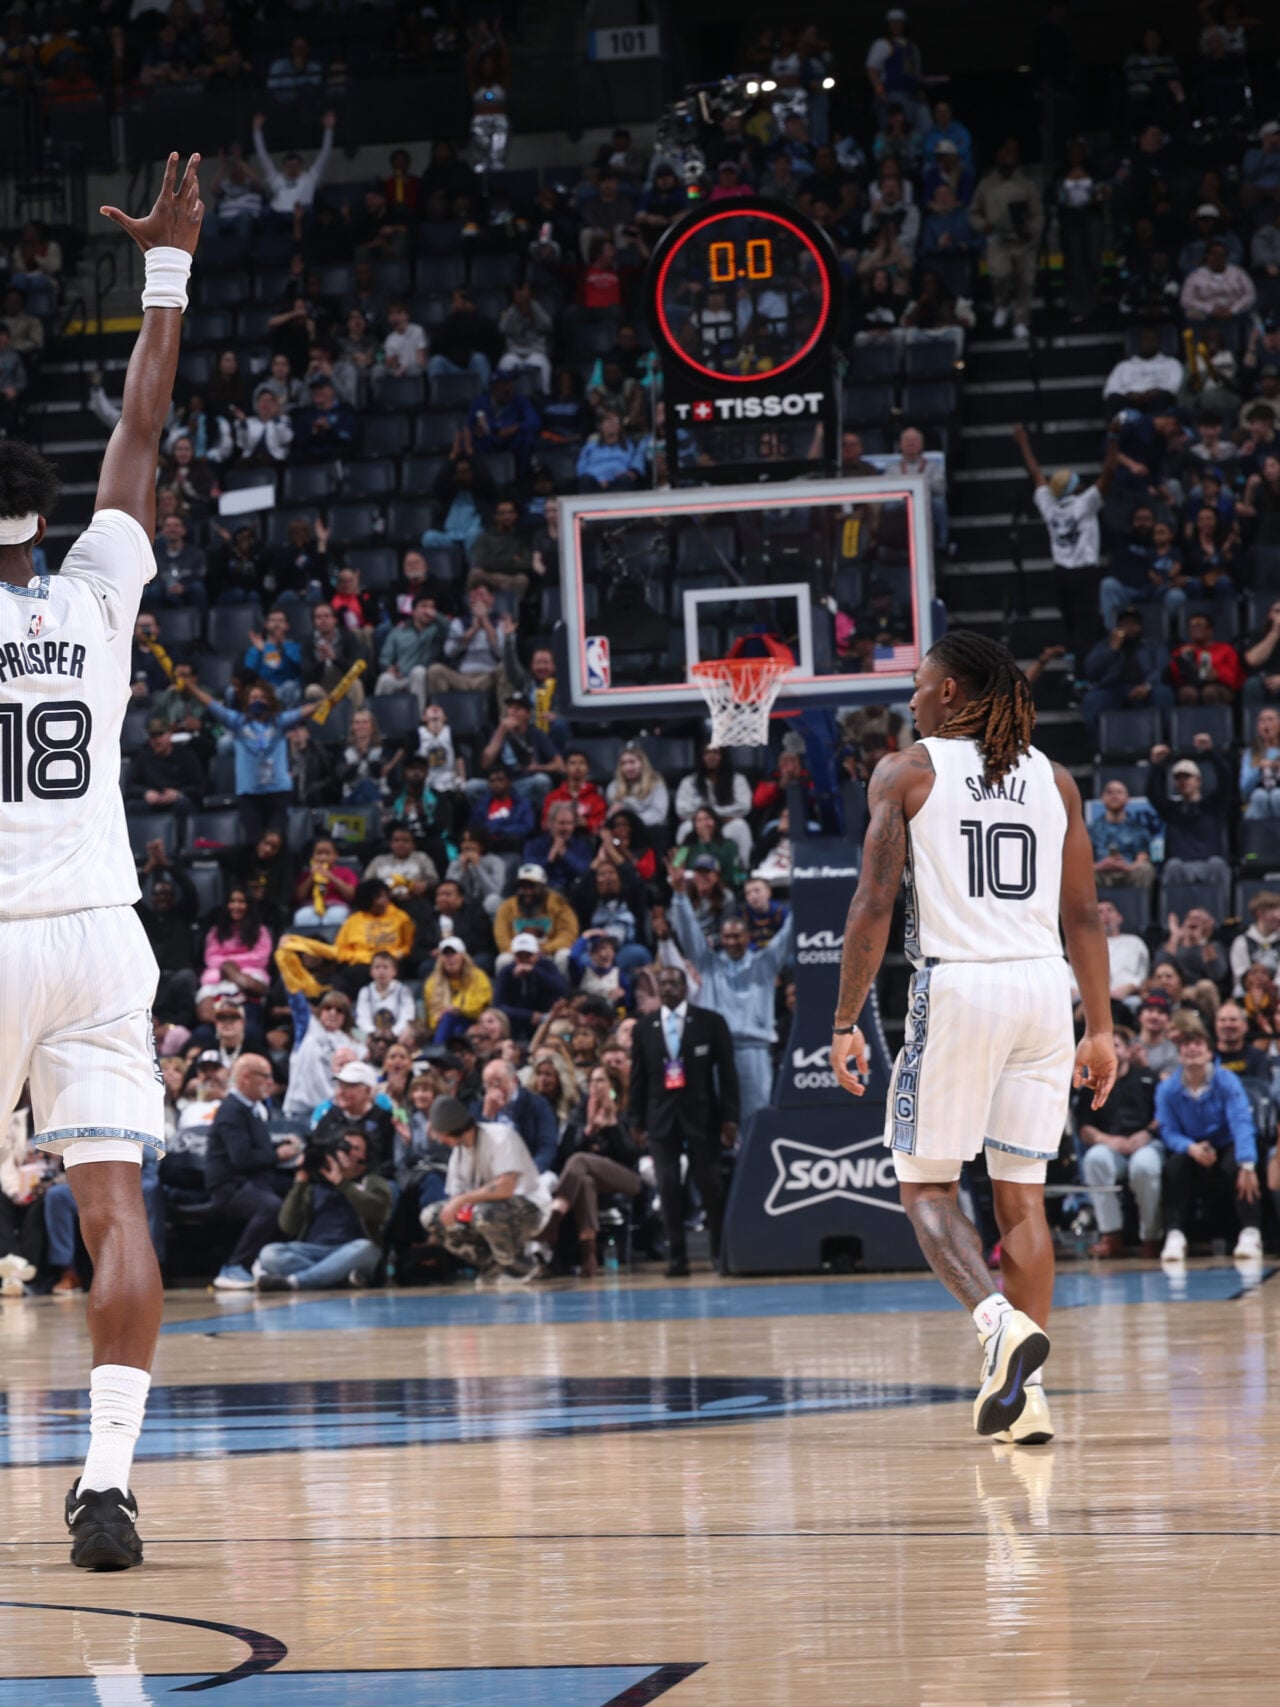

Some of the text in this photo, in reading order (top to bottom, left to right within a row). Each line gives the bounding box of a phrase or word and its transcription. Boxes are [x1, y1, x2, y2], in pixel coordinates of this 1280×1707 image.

[610, 29, 647, 54] 101
[710, 239, 773, 282] 0.0
[714, 392, 824, 420] TISSOT
[965, 774, 1027, 806] SMALL
[960, 820, 1037, 900] 10
[797, 950, 841, 965] GOSSE
[794, 1070, 872, 1089] GOSST
[784, 1157, 897, 1190] SONIC
